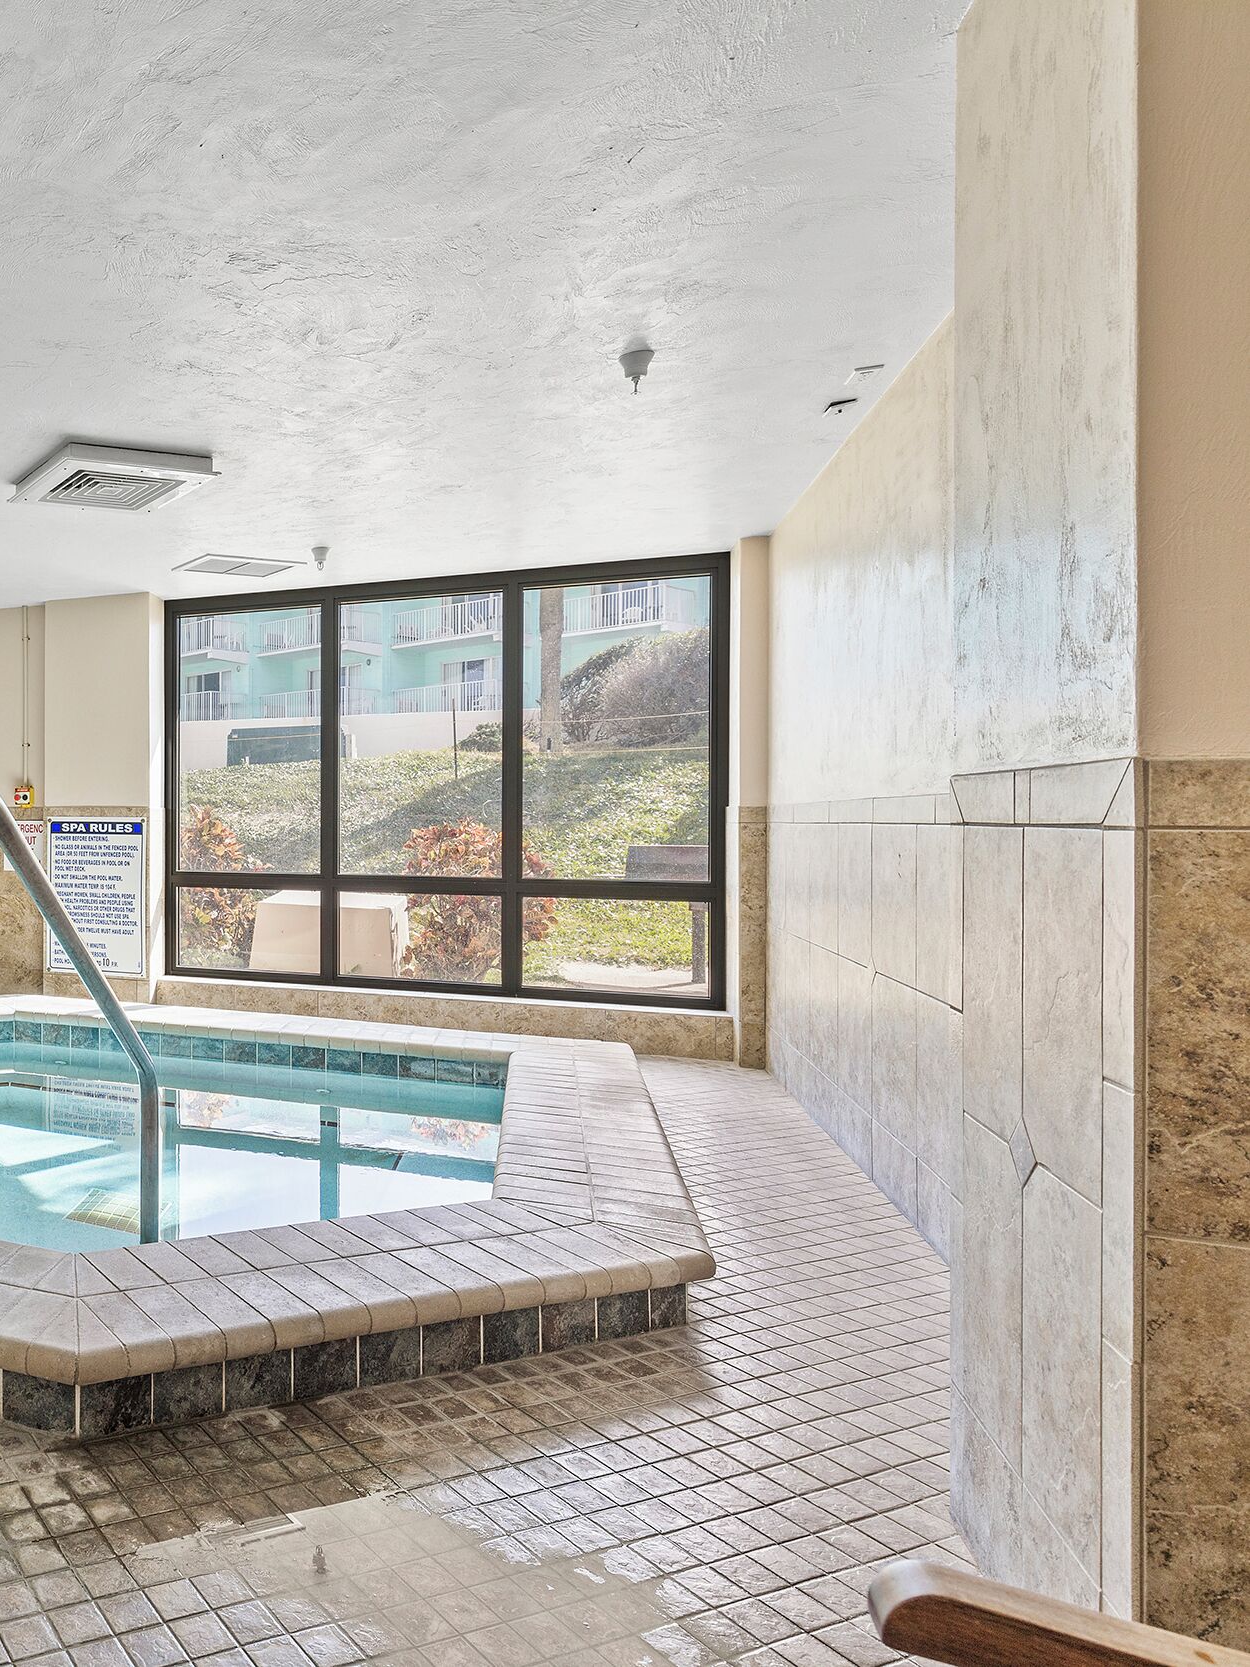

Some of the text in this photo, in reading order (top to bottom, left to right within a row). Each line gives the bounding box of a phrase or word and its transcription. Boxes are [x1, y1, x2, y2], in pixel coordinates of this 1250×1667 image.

[18, 824, 43, 833] RGENC
[62, 823, 133, 833] SPA RULES
[102, 958, 110, 966] 10
